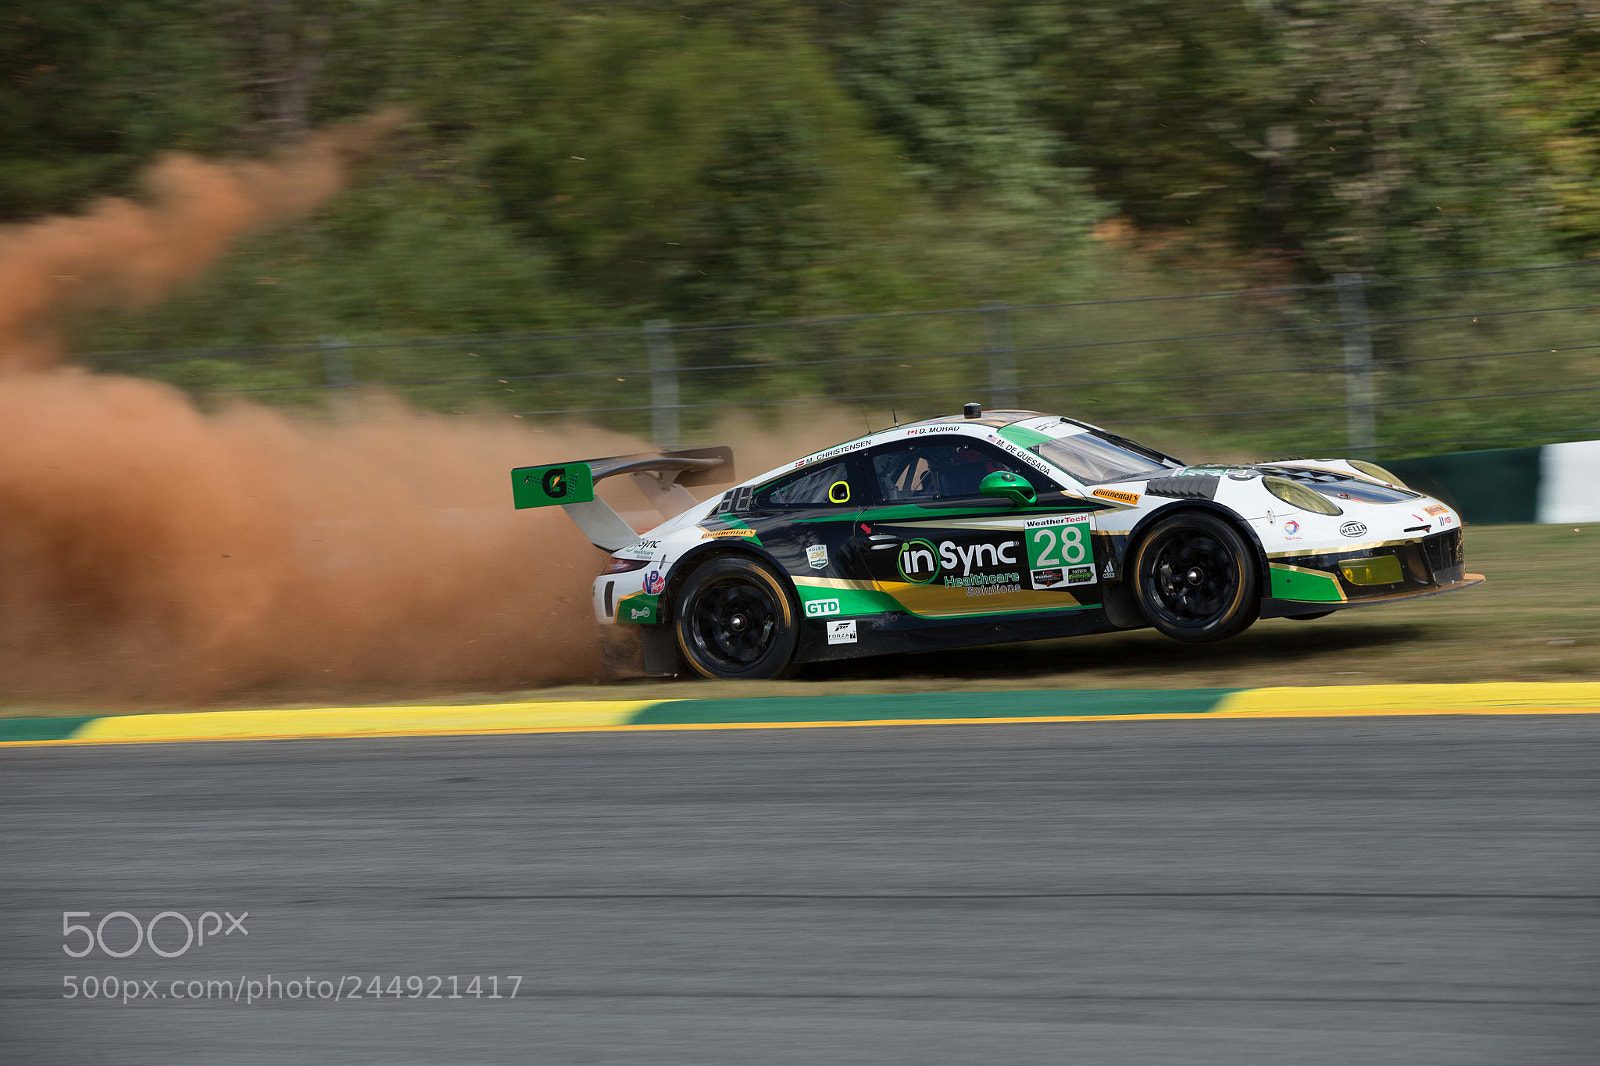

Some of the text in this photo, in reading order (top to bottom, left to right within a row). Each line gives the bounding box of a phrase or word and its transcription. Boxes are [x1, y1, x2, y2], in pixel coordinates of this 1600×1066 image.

[816, 440, 872, 460] CHRISTENSEN
[996, 439, 1051, 476] M. DE QUESADA
[542, 468, 567, 498] G
[1092, 488, 1133, 502] Continental
[1026, 515, 1088, 527] WeatherTech
[1033, 526, 1086, 567] 28
[644, 570, 660, 595] VP
[944, 572, 1020, 588] Healthcare
[966, 584, 1022, 597] Solutions
[807, 601, 838, 614] GTD
